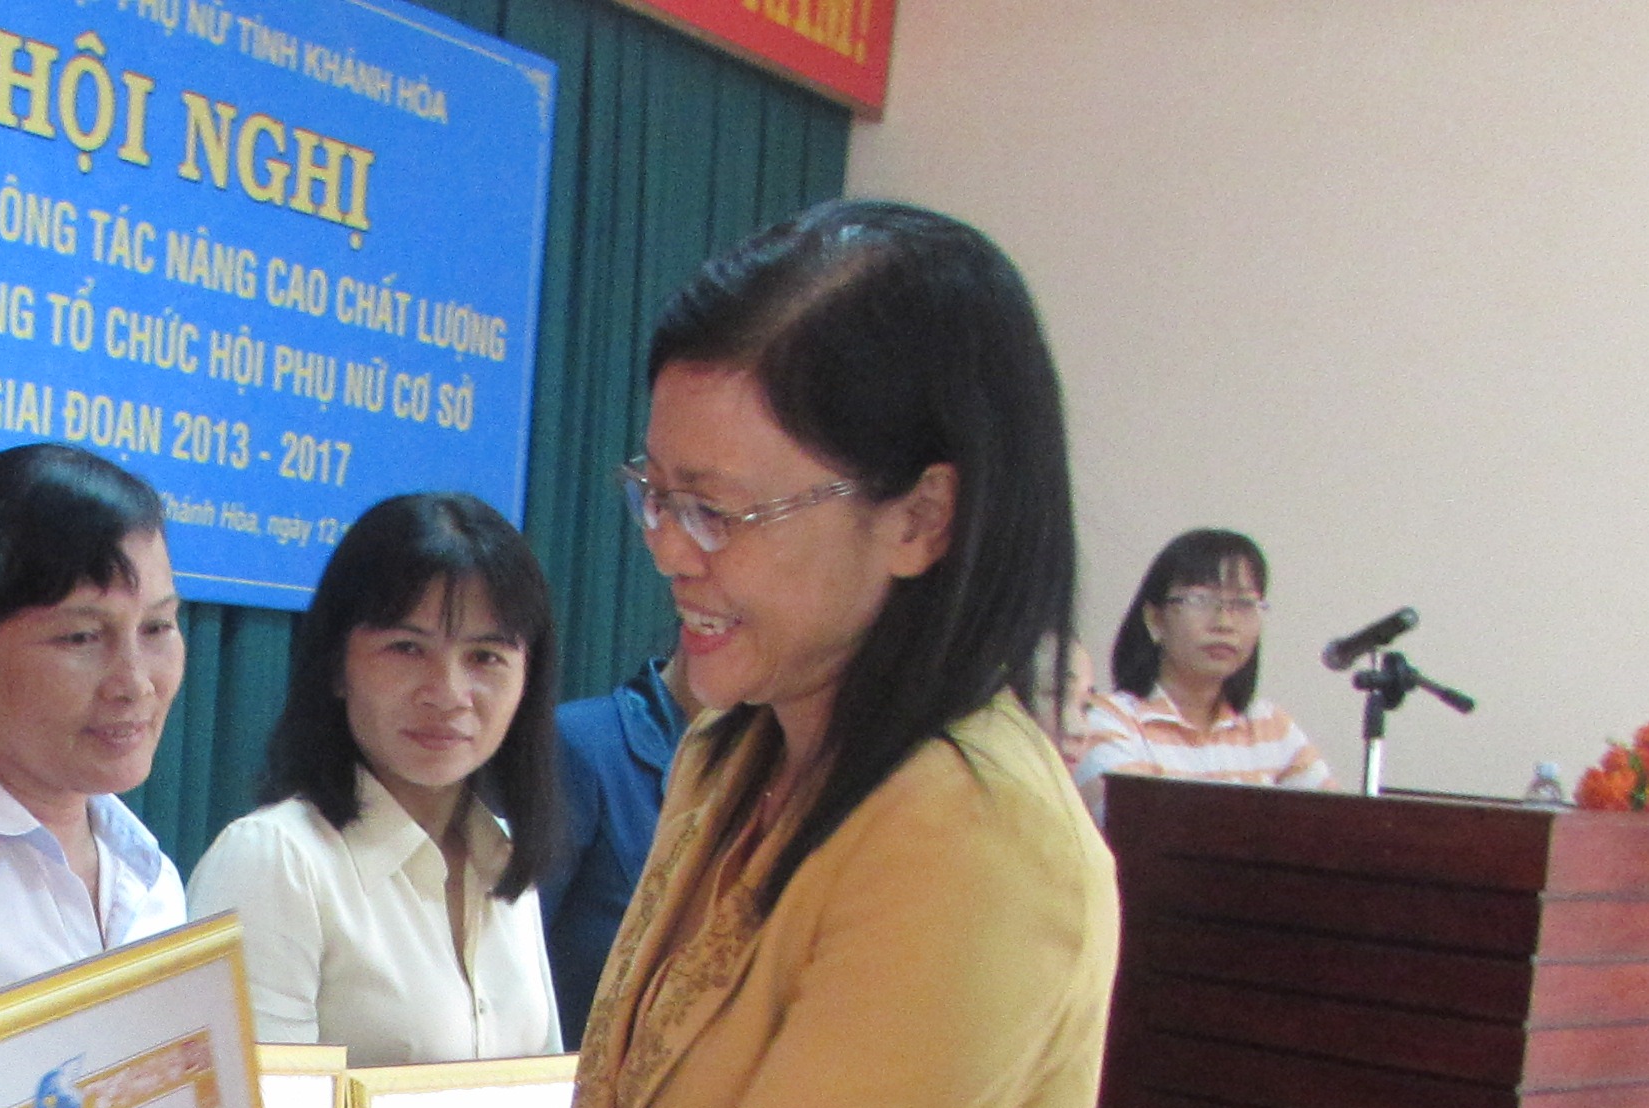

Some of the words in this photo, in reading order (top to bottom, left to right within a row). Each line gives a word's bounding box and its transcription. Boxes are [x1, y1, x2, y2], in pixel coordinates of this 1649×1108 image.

[304, 42, 391, 106] KHÁNH
[178, 89, 376, 250] NGHỊ
[48, 275, 96, 353] TỔ
[104, 304, 200, 375] CHỨC
[208, 324, 266, 396] HỘI
[272, 344, 338, 412] PHỤ
[343, 355, 387, 413] NỮ
[392, 370, 433, 423] CƠ
[437, 373, 475, 432] SỞ
[88, 203, 155, 275] TÁC
[165, 225, 258, 300] NÂNG
[265, 256, 329, 317] CAO
[335, 272, 412, 337] CHẤT
[417, 297, 507, 362] LƯỢNG
[62, 389, 164, 462] ĐOẠN
[171, 410, 251, 471] 2013
[258, 450, 272, 462] -
[279, 430, 353, 488] 2017
